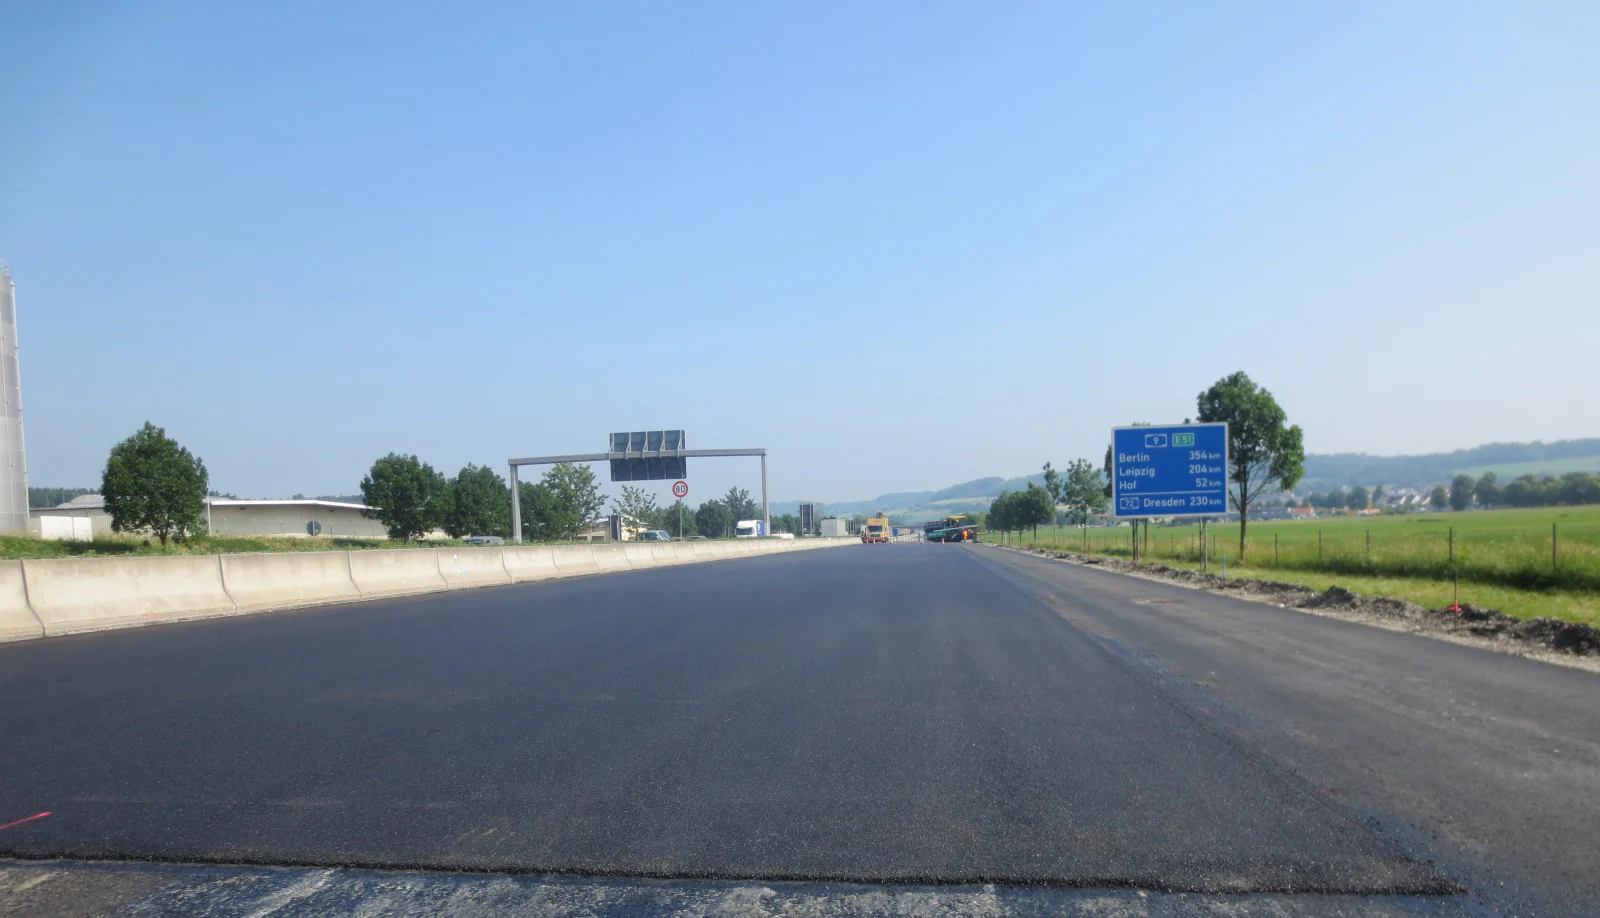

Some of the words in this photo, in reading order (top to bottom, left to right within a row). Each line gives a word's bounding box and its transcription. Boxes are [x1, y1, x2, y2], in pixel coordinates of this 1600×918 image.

[1153, 436, 1159, 445] 9
[1120, 453, 1150, 462] Berlin
[1189, 450, 1207, 460] 354
[1209, 451, 1221, 459] km
[1120, 467, 1155, 477] Leipzig
[1189, 464, 1207, 474] 204
[676, 485, 686, 493] 80
[1120, 481, 1136, 490] Hof
[1196, 478, 1207, 487] 52
[1144, 498, 1185, 507] Dresden
[1190, 496, 1208, 506] 230
